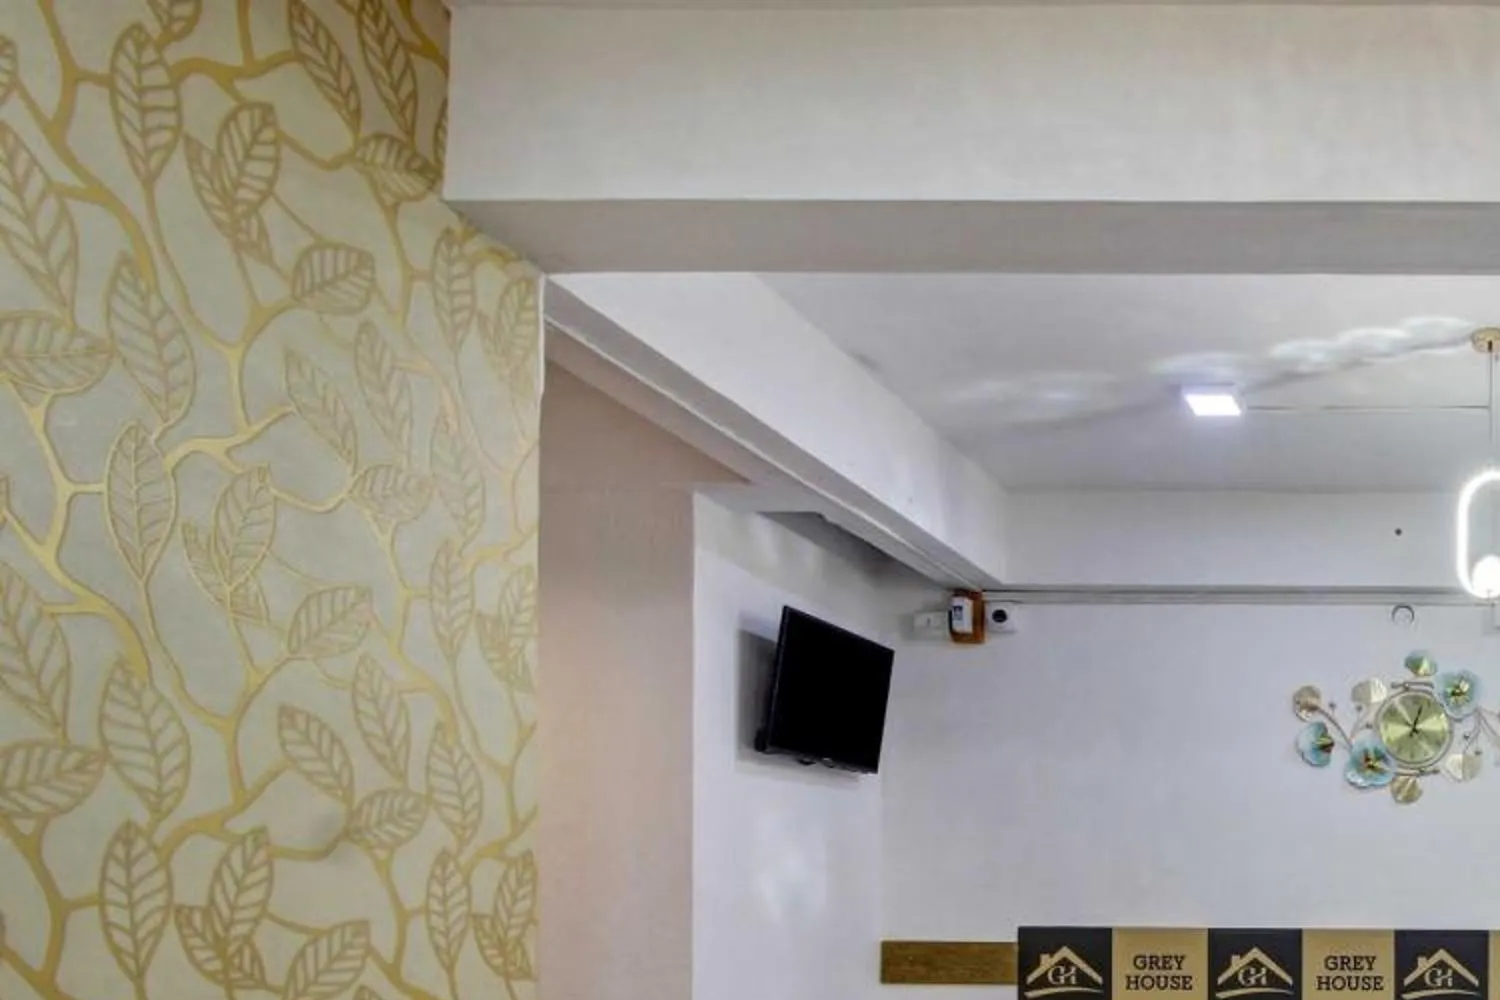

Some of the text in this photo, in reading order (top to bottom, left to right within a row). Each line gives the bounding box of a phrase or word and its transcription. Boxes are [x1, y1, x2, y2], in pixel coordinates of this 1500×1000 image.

[1132, 955, 1187, 971] GREY
[1323, 955, 1377, 971] GREY
[1125, 975, 1193, 992] HOUSE
[1316, 976, 1384, 992] HOUSE
